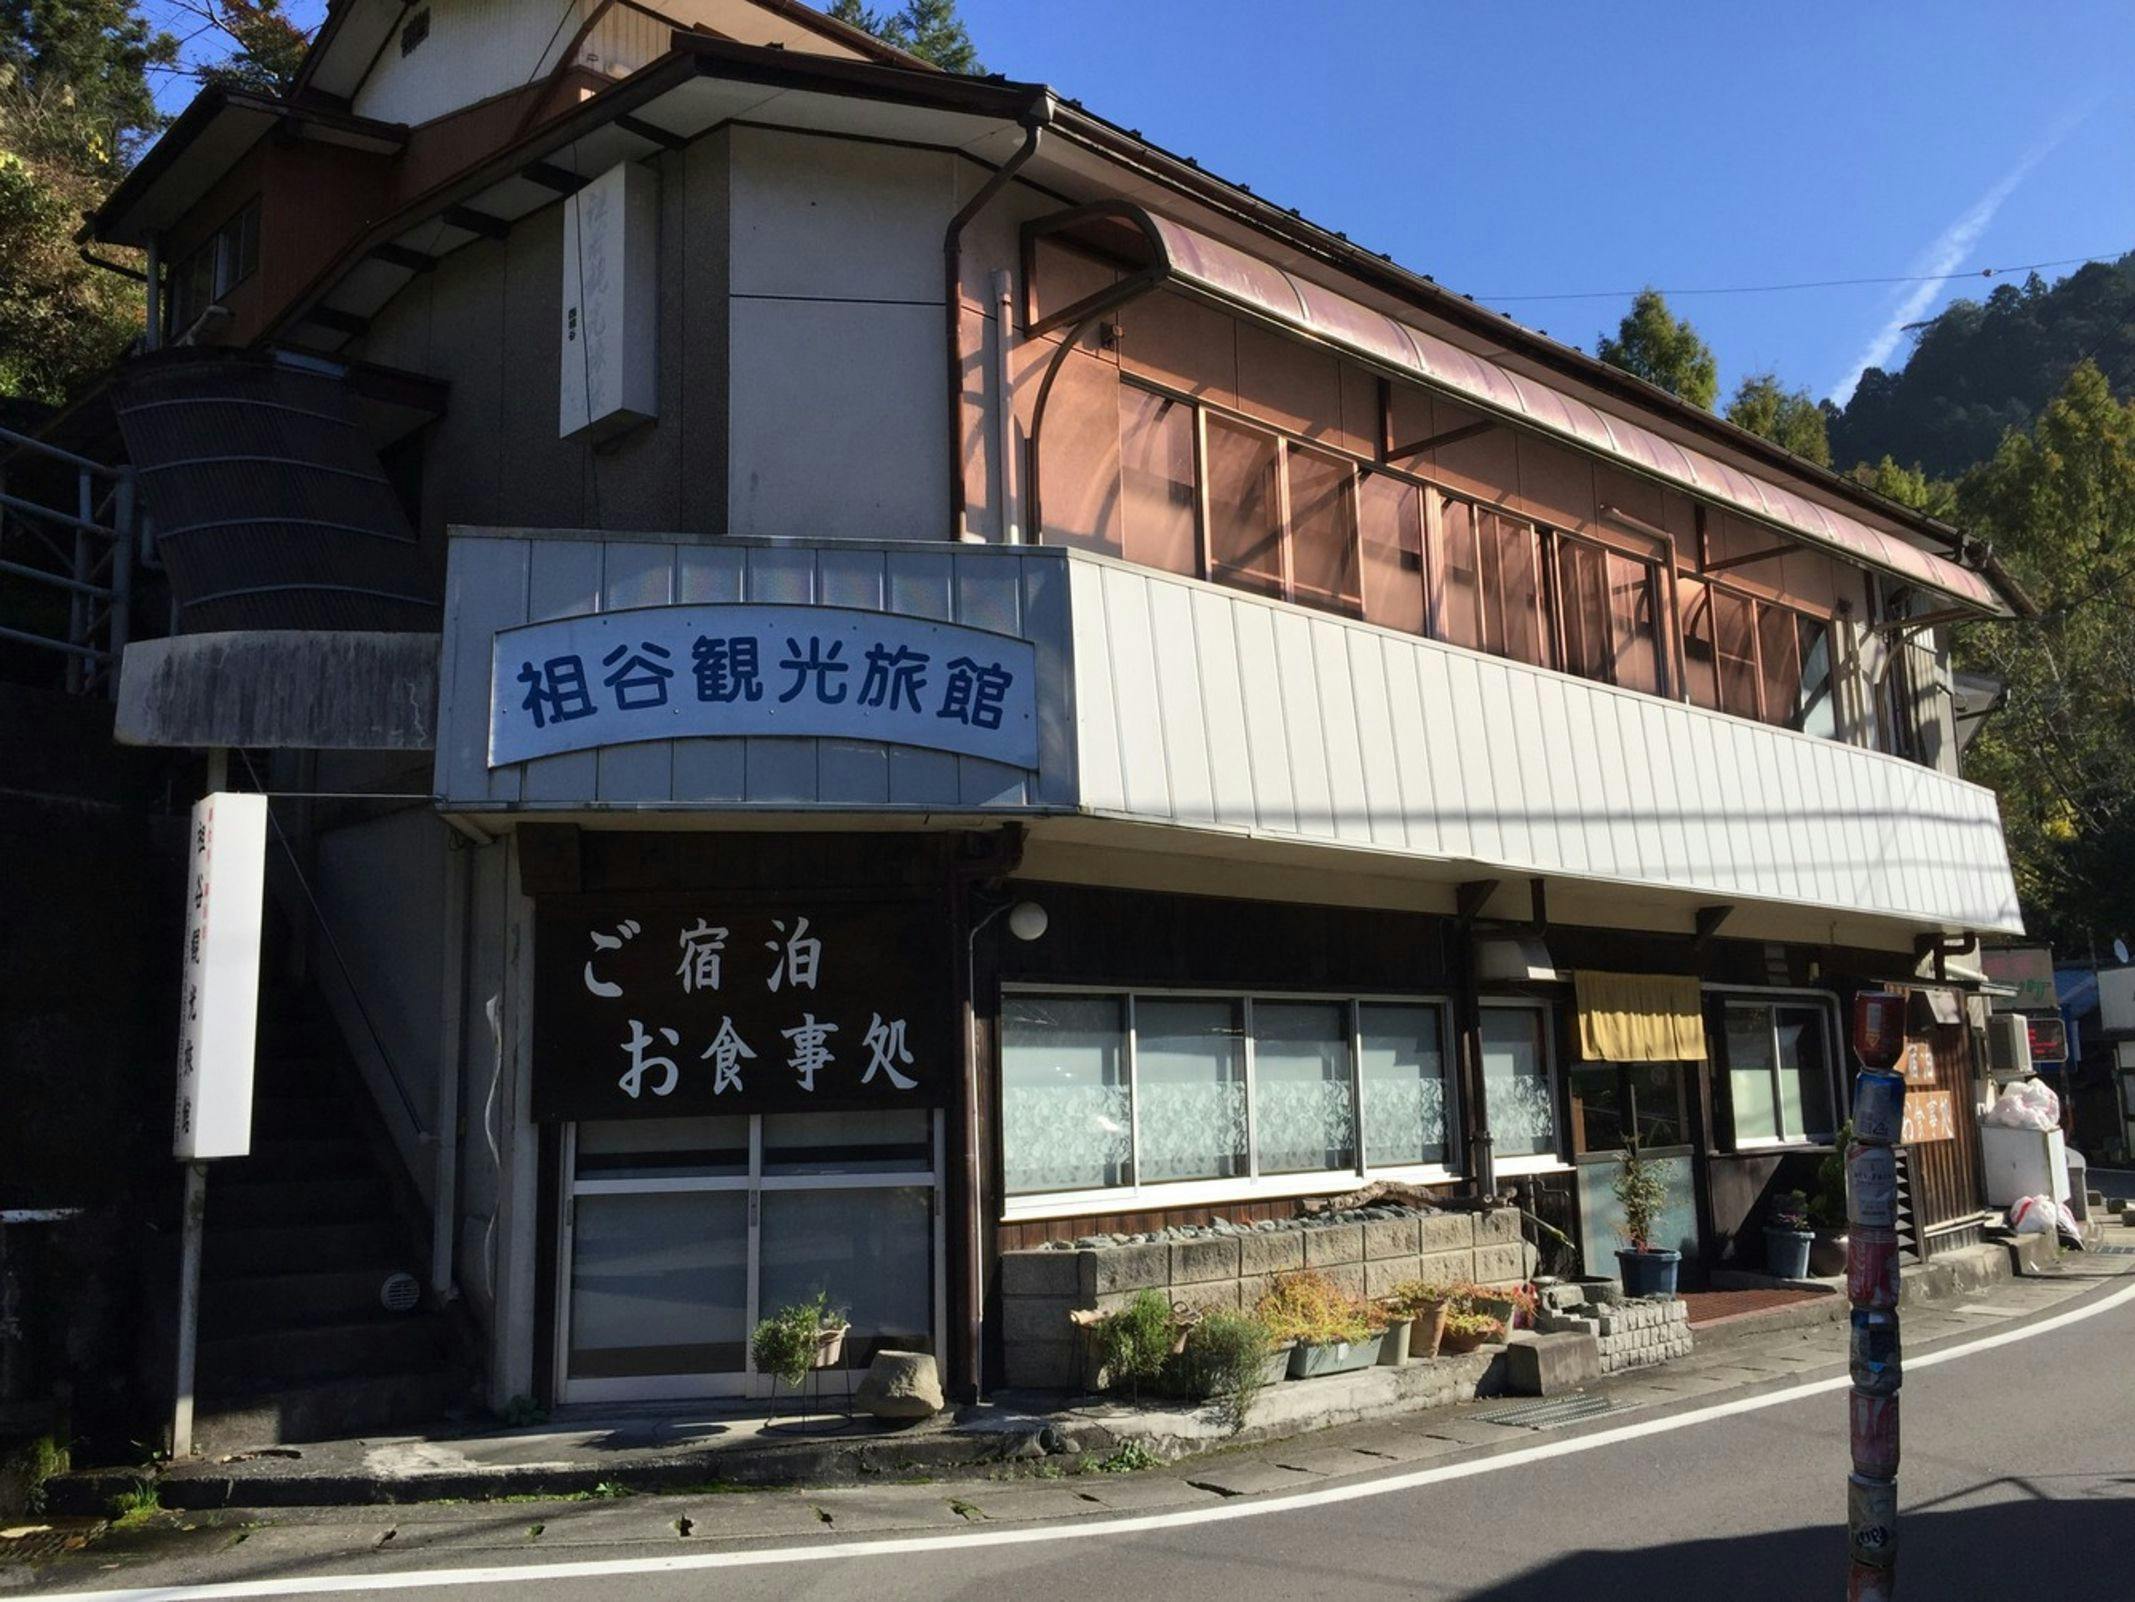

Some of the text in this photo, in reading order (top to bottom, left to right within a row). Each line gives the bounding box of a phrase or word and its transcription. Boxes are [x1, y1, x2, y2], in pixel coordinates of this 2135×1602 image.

[516, 635, 1014, 731] 祖谷観光旅館
[584, 916, 824, 998] ご宿泊
[618, 1011, 919, 1099] お食事処
